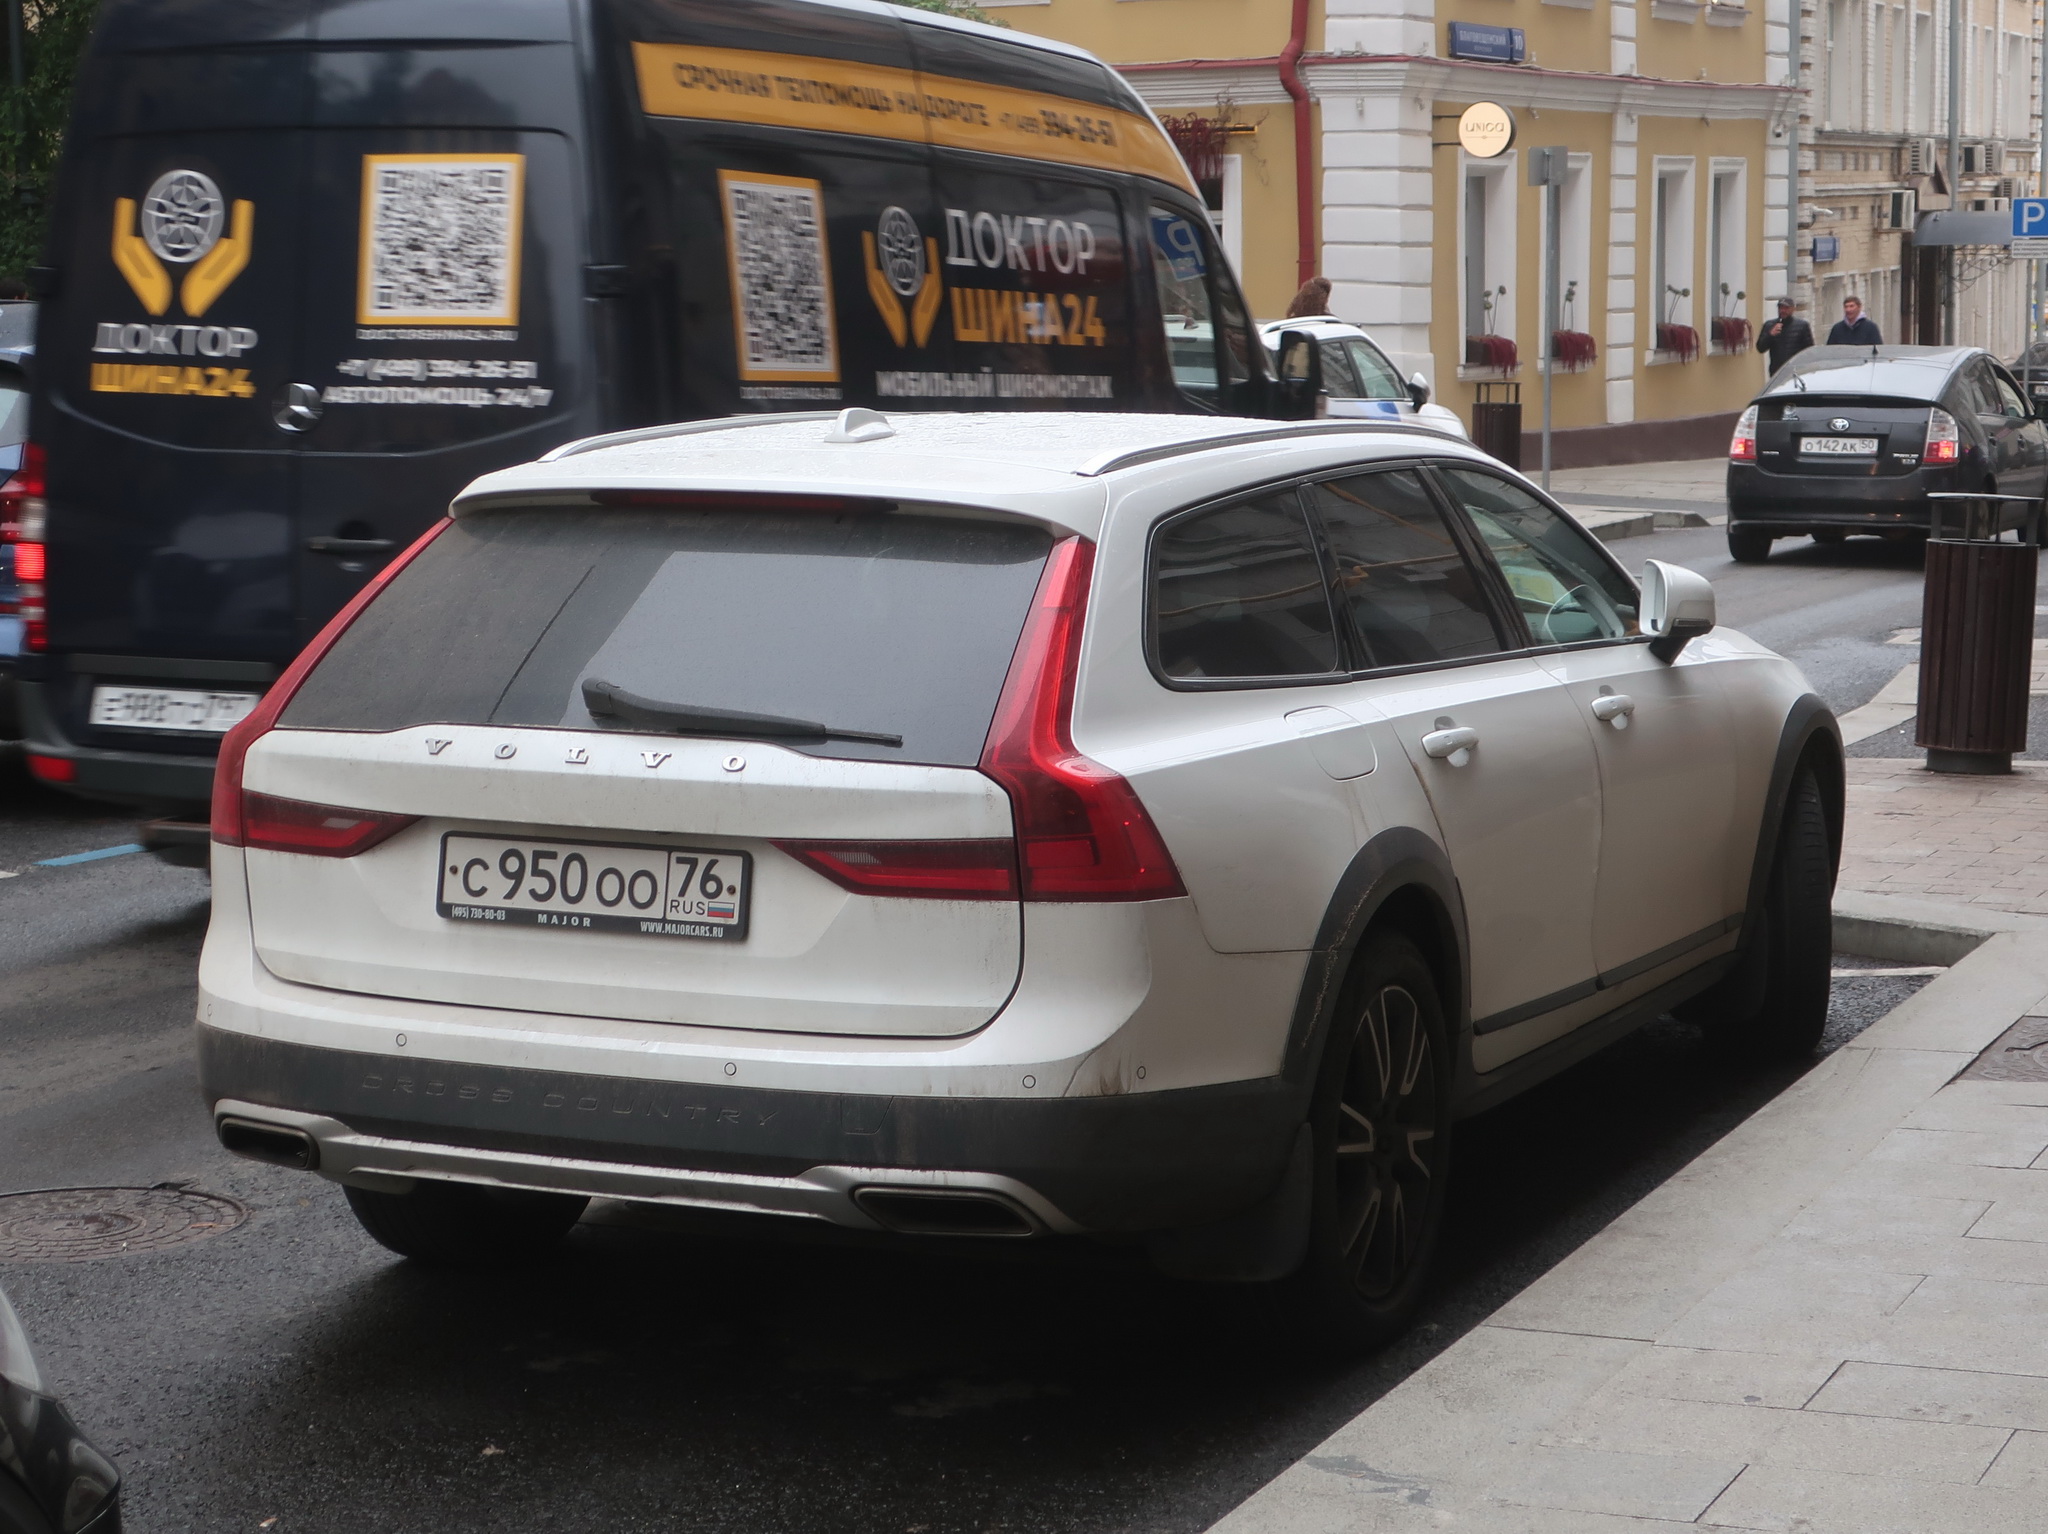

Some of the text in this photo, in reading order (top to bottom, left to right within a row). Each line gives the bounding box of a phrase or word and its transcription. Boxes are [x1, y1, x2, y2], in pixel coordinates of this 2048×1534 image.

[1513, 35, 1523, 50] 10
[673, 61, 771, 98] СРОЧНАЯ
[772, 75, 892, 115] ТЕХПОМОЩЬ
[923, 94, 989, 127] ДОРОГЕ
[2022, 201, 2046, 233] P
[945, 208, 1096, 275] ДОКТОР
[950, 286, 1107, 346] ШИНА24
[91, 322, 258, 357] ДОКТОР
[90, 362, 257, 398] ШИНА24
[876, 366, 1114, 398] МОБИЛЬНЫЙ ШИНОМОНТАЖ
[1861, 440, 1875, 450] 50
[426, 738, 747, 772] VOLVO
[675, 856, 723, 899] 76
[452, 905, 506, 921] (495) 730-80-03
[537, 913, 591, 927] MAJOR
[669, 899, 706, 916] RUS
[640, 921, 724, 938] WWW.MAJORCARS.RU
[362, 1073, 780, 1127] CROSS COUNTRY
